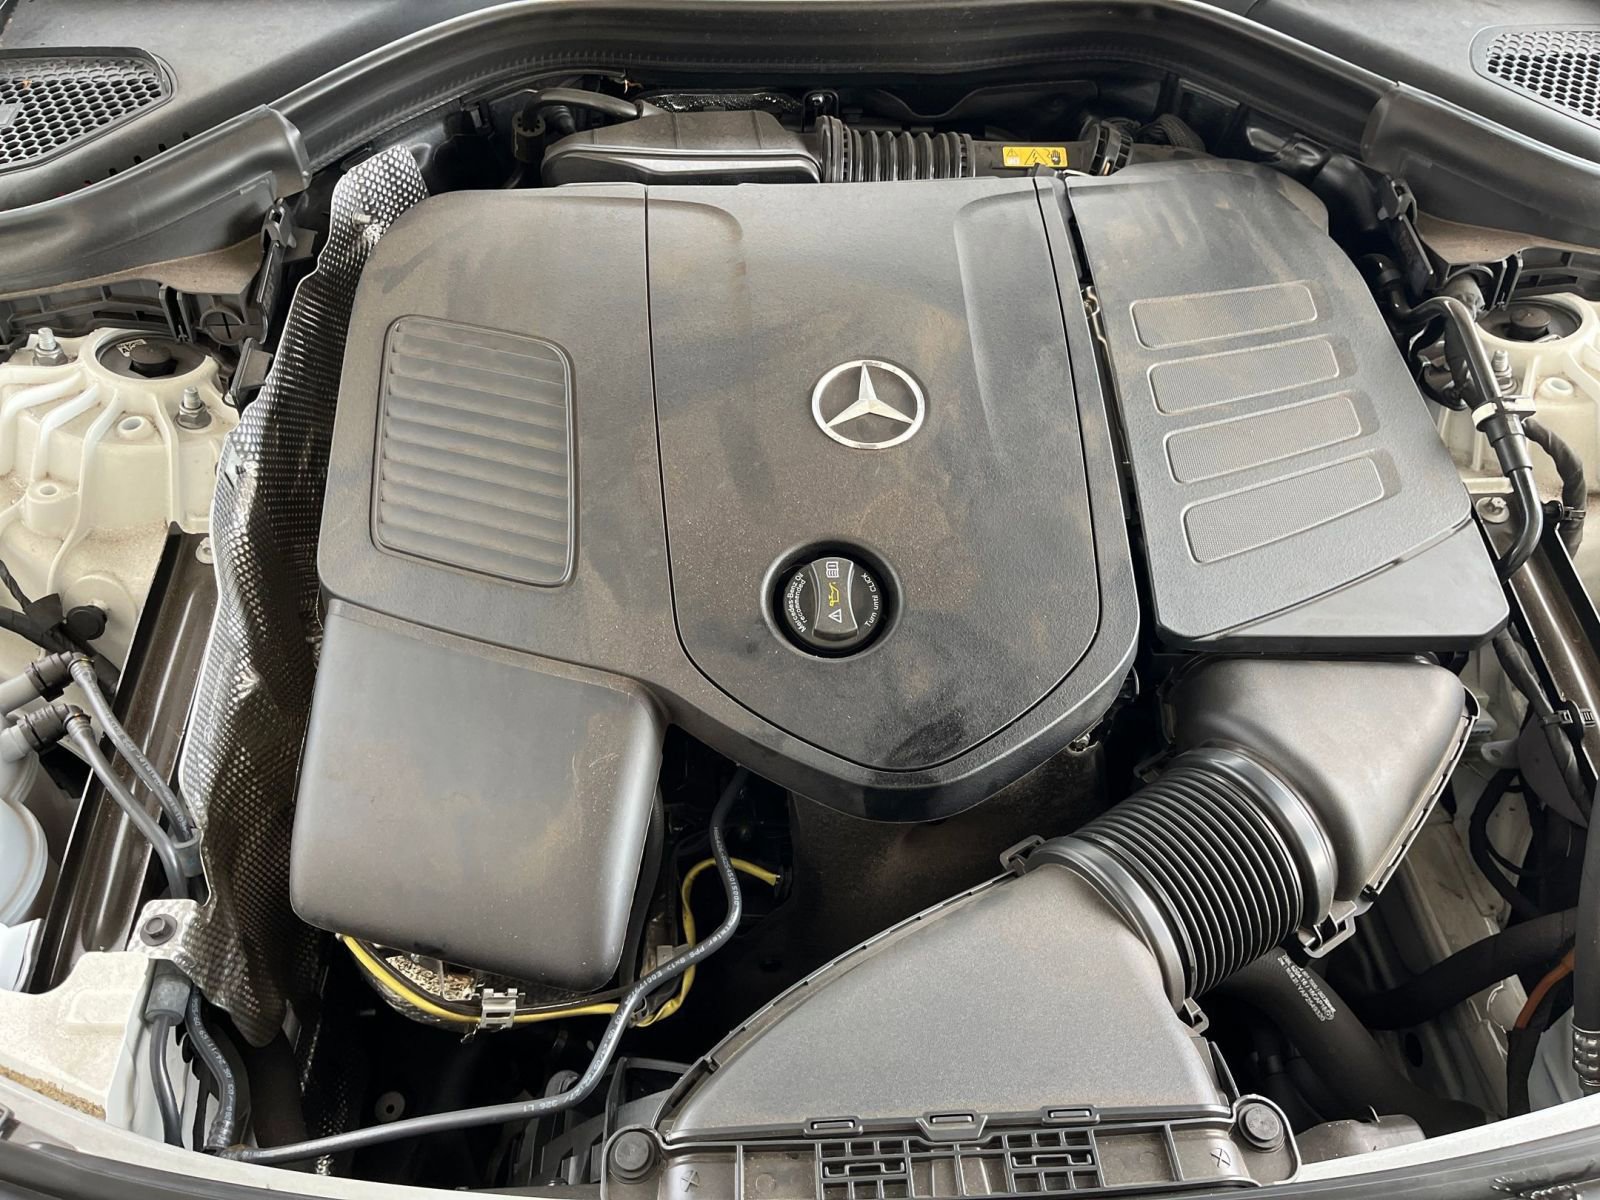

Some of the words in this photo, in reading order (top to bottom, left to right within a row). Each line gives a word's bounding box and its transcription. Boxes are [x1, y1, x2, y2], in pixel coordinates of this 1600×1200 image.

[861, 573, 877, 593] CLICK
[787, 582, 806, 632] Mercedes-Benz
[795, 579, 807, 623] recommended
[864, 612, 877, 627] Turn
